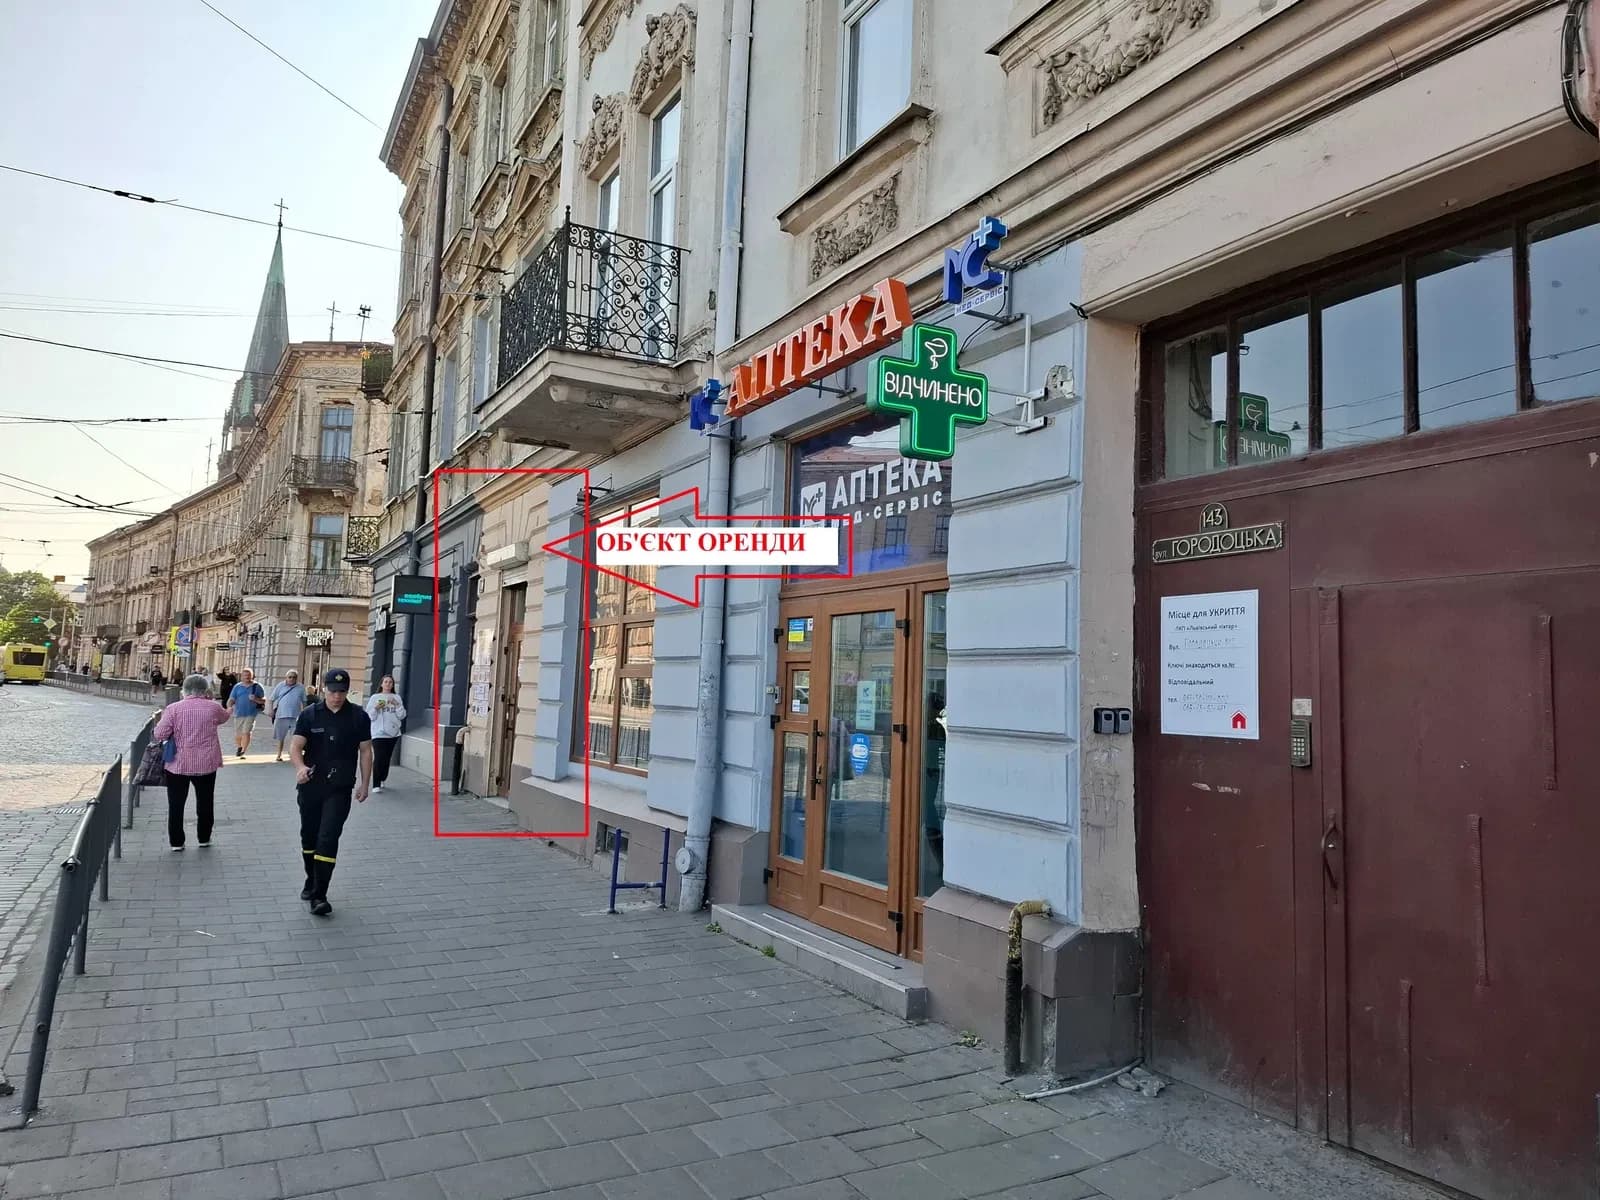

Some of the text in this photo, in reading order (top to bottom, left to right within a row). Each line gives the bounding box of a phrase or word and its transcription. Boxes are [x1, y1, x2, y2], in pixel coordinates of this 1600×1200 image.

[724, 277, 908, 416] АПТЕКА
[884, 371, 983, 408] ВІДЧИНЕНО
[831, 457, 943, 510] АПТЕКА
[1202, 508, 1223, 528] 143
[1171, 528, 1277, 557] ГОРОДОЦЬКА
[1168, 606, 1246, 620] Місце для УКРИТТЯ
